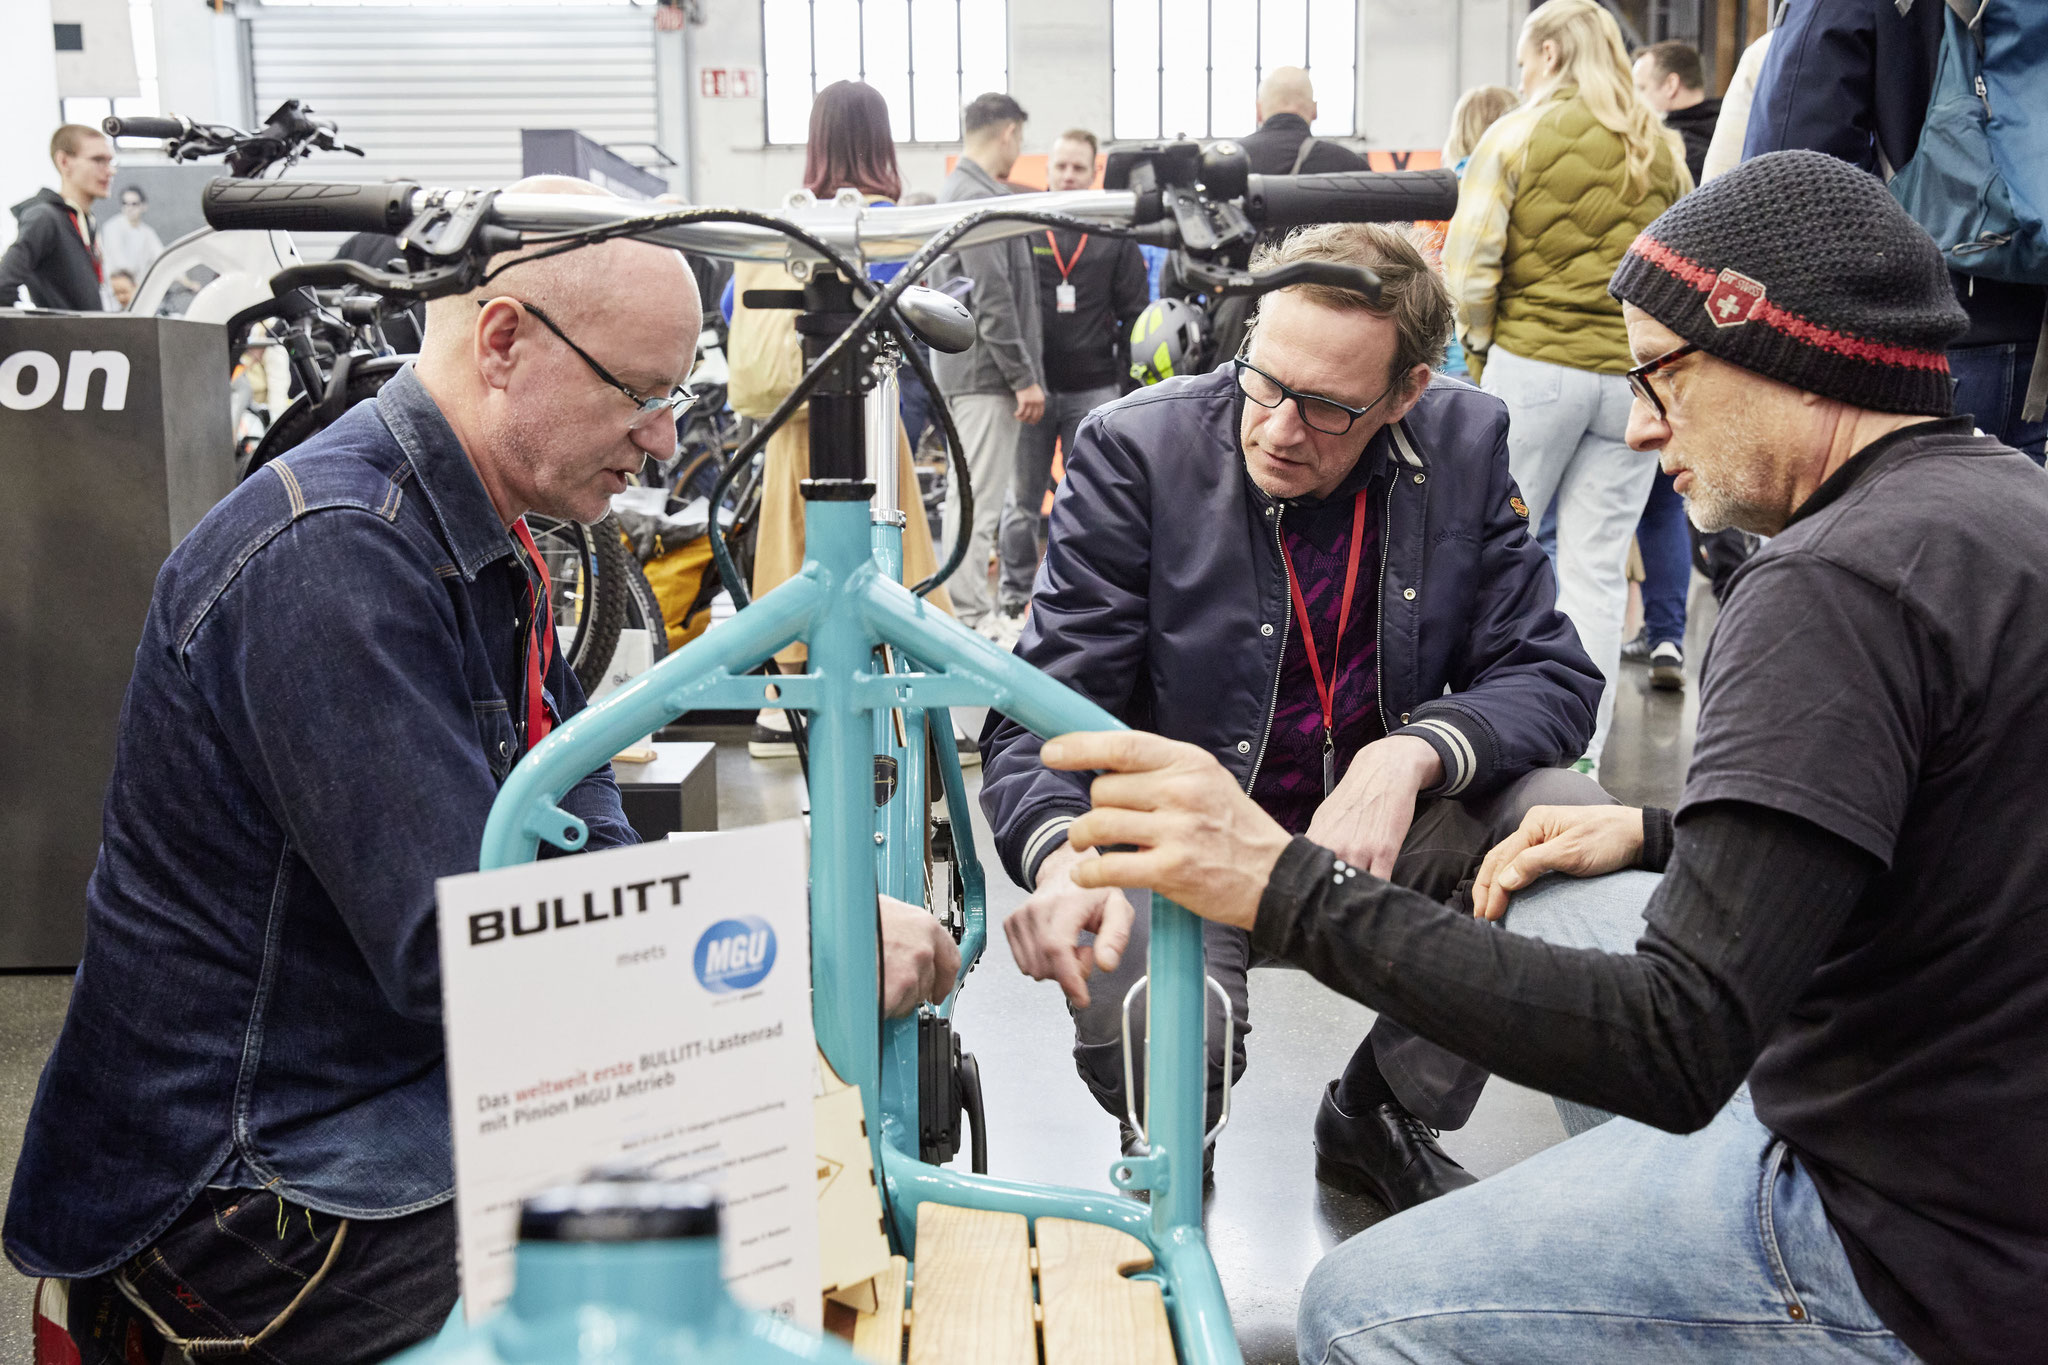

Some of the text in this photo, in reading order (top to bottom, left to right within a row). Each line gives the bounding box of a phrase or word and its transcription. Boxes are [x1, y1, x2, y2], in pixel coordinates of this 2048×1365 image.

[1720, 273, 1762, 297] DT SWISS
[0, 350, 131, 411] on
[468, 873, 690, 946] BULLITT
[616, 946, 667, 966] meets
[705, 929, 769, 976] MGU
[477, 1021, 783, 1113] Das weltweit erste BULLITT-Lastenrad
[479, 1071, 677, 1135] mit Pinion MGU Antrieb
